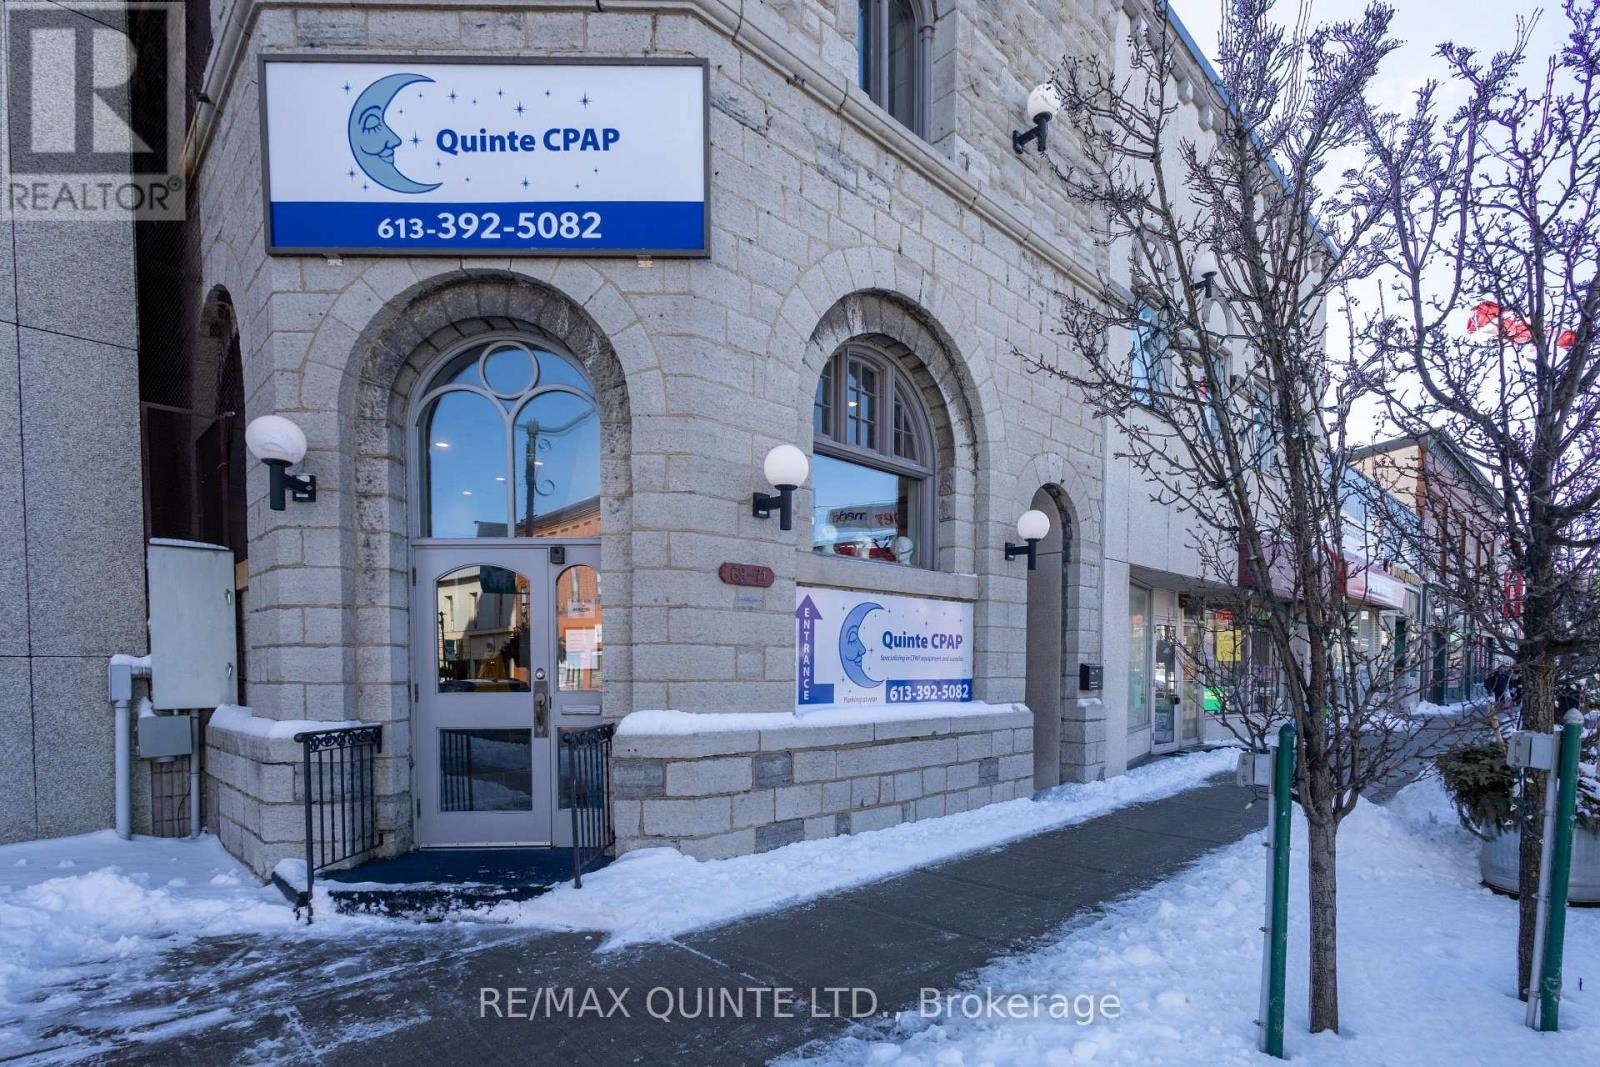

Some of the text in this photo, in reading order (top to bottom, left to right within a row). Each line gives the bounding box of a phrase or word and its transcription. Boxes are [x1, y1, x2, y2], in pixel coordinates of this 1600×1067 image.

[436, 128, 620, 155] Quinte CPAP
[377, 212, 602, 239] 613-392-5082
[882, 630, 963, 650] Quinte CPAP
[802, 607, 811, 701] ENTRANCE
[889, 684, 969, 702] 613-392-5082
